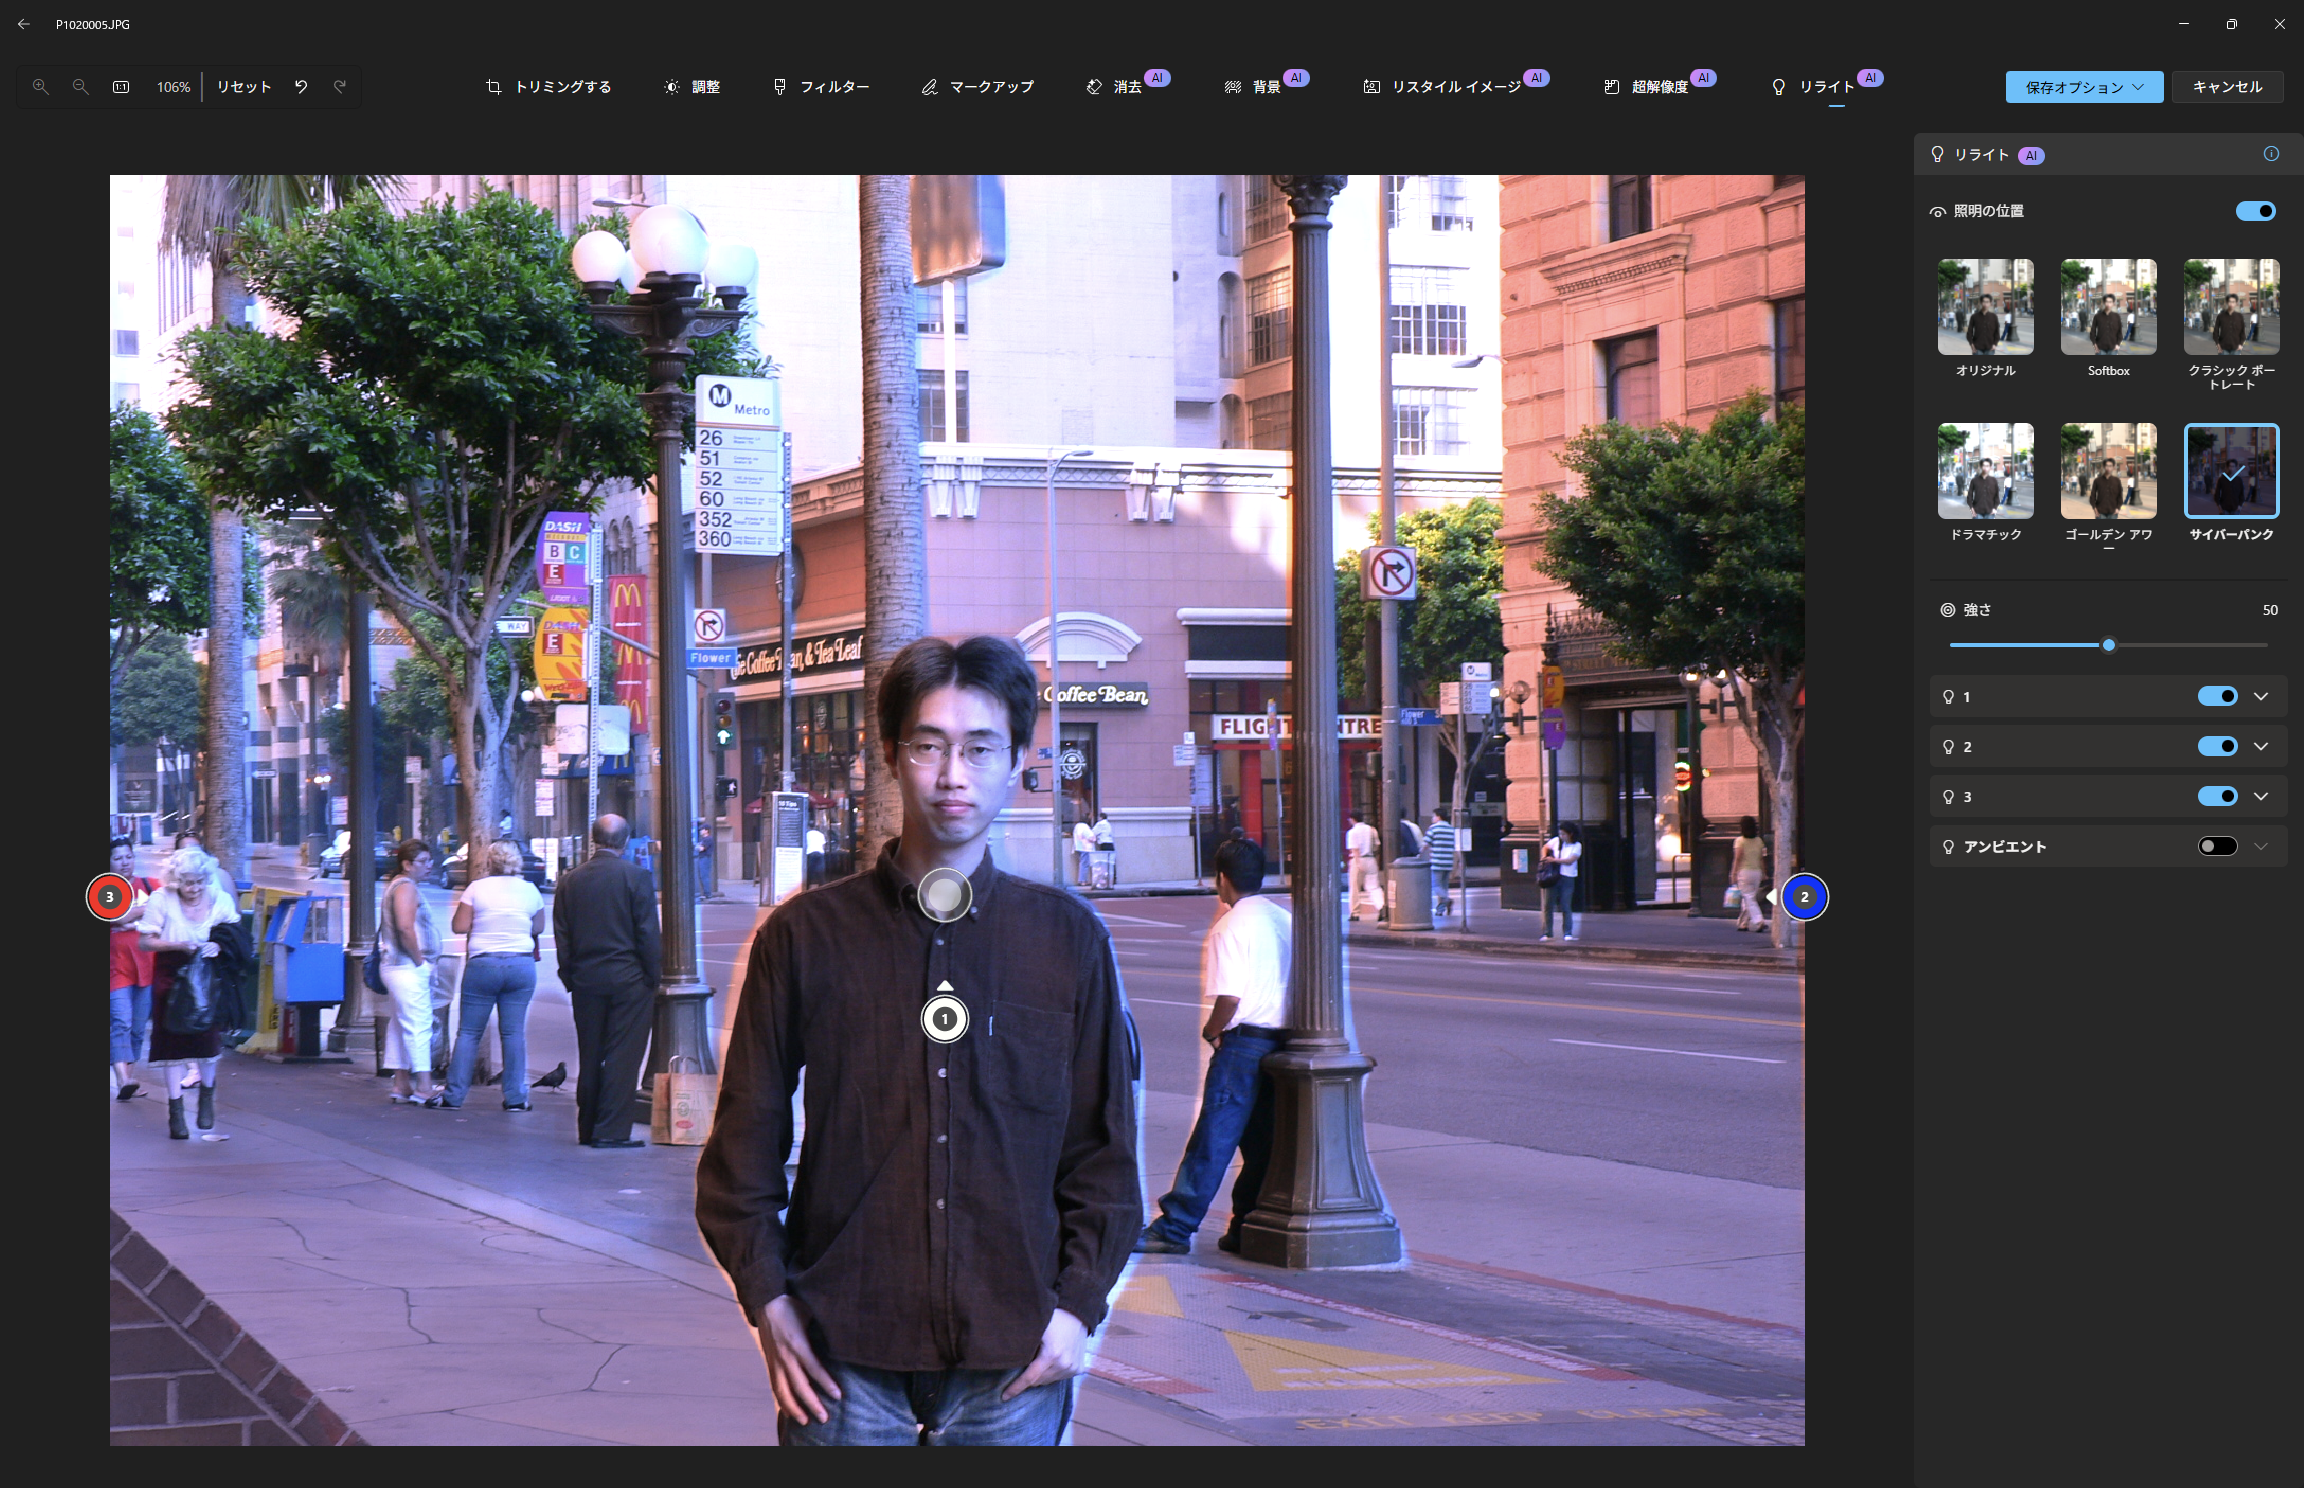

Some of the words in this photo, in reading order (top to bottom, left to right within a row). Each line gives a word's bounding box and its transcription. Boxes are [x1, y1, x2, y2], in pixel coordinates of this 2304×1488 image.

[57, 20, 129, 29] P1020005.JPG
[1152, 73, 1162, 82] AI
[1291, 73, 1301, 82] AI
[1531, 73, 1541, 82] AI
[1698, 73, 1708, 82] AI
[1865, 73, 1875, 82] AI
[157, 82, 191, 92] 106%
[219, 81, 271, 93] リセット
[518, 80, 611, 93] トリミングする
[692, 80, 720, 93] 調整
[801, 80, 869, 93] フィルター
[951, 80, 1034, 93] マークアップ
[1114, 80, 1142, 93] 消去
[1253, 80, 1281, 94] 背景
[1394, 80, 1460, 93] リスタイル
[1466, 80, 1521, 93] イメージ
[1632, 80, 1688, 94] 超解像度
[1802, 80, 1855, 93] リライト
[2026, 81, 2123, 94] 保存オプション
[2194, 81, 2263, 93] キャンセル
[1956, 149, 2008, 161] リライト
[2026, 151, 2036, 160] AI
[1954, 204, 2024, 217] 照明の位置
[1957, 365, 2016, 376] オリジナル
[2089, 366, 2130, 375] Softbox
[2211, 380, 2254, 390] トレート
[711, 385, 730, 406] M
[734, 404, 770, 416] Metro
[700, 429, 722, 446] 26
[700, 450, 718, 466] 51
[700, 471, 722, 486] 52
[700, 491, 724, 507] 60
[700, 511, 732, 528] 352
[544, 521, 582, 532] DASH
[699, 530, 732, 547] 360
[1953, 529, 2021, 540] ドラマチック
[2067, 529, 2125, 540] ゴールデン
[2130, 530, 2152, 540] アワ
[2190, 529, 2273, 540] サイバーパンク
[550, 545, 559, 558] B
[570, 546, 580, 559] C
[550, 565, 560, 578] E
[1964, 603, 1990, 616] 強さ
[2264, 605, 2278, 615] 50
[507, 622, 526, 630] WAY
[547, 634, 559, 648] E
[690, 653, 732, 663] Flower
[747, 650, 775, 675] Coffee
[805, 642, 814, 666] &
[814, 640, 833, 664] Tea
[834, 636, 864, 662] Leaf
[1044, 686, 1097, 702] Coffee
[1098, 685, 1149, 706] Bean
[1964, 692, 1969, 702] 1
[1964, 742, 1971, 752] 2
[1964, 792, 1971, 802] 3
[1965, 840, 2046, 853] アンビエント
[106, 891, 114, 903] 3
[1800, 891, 1809, 903] 2
[941, 1014, 948, 1024] 1
